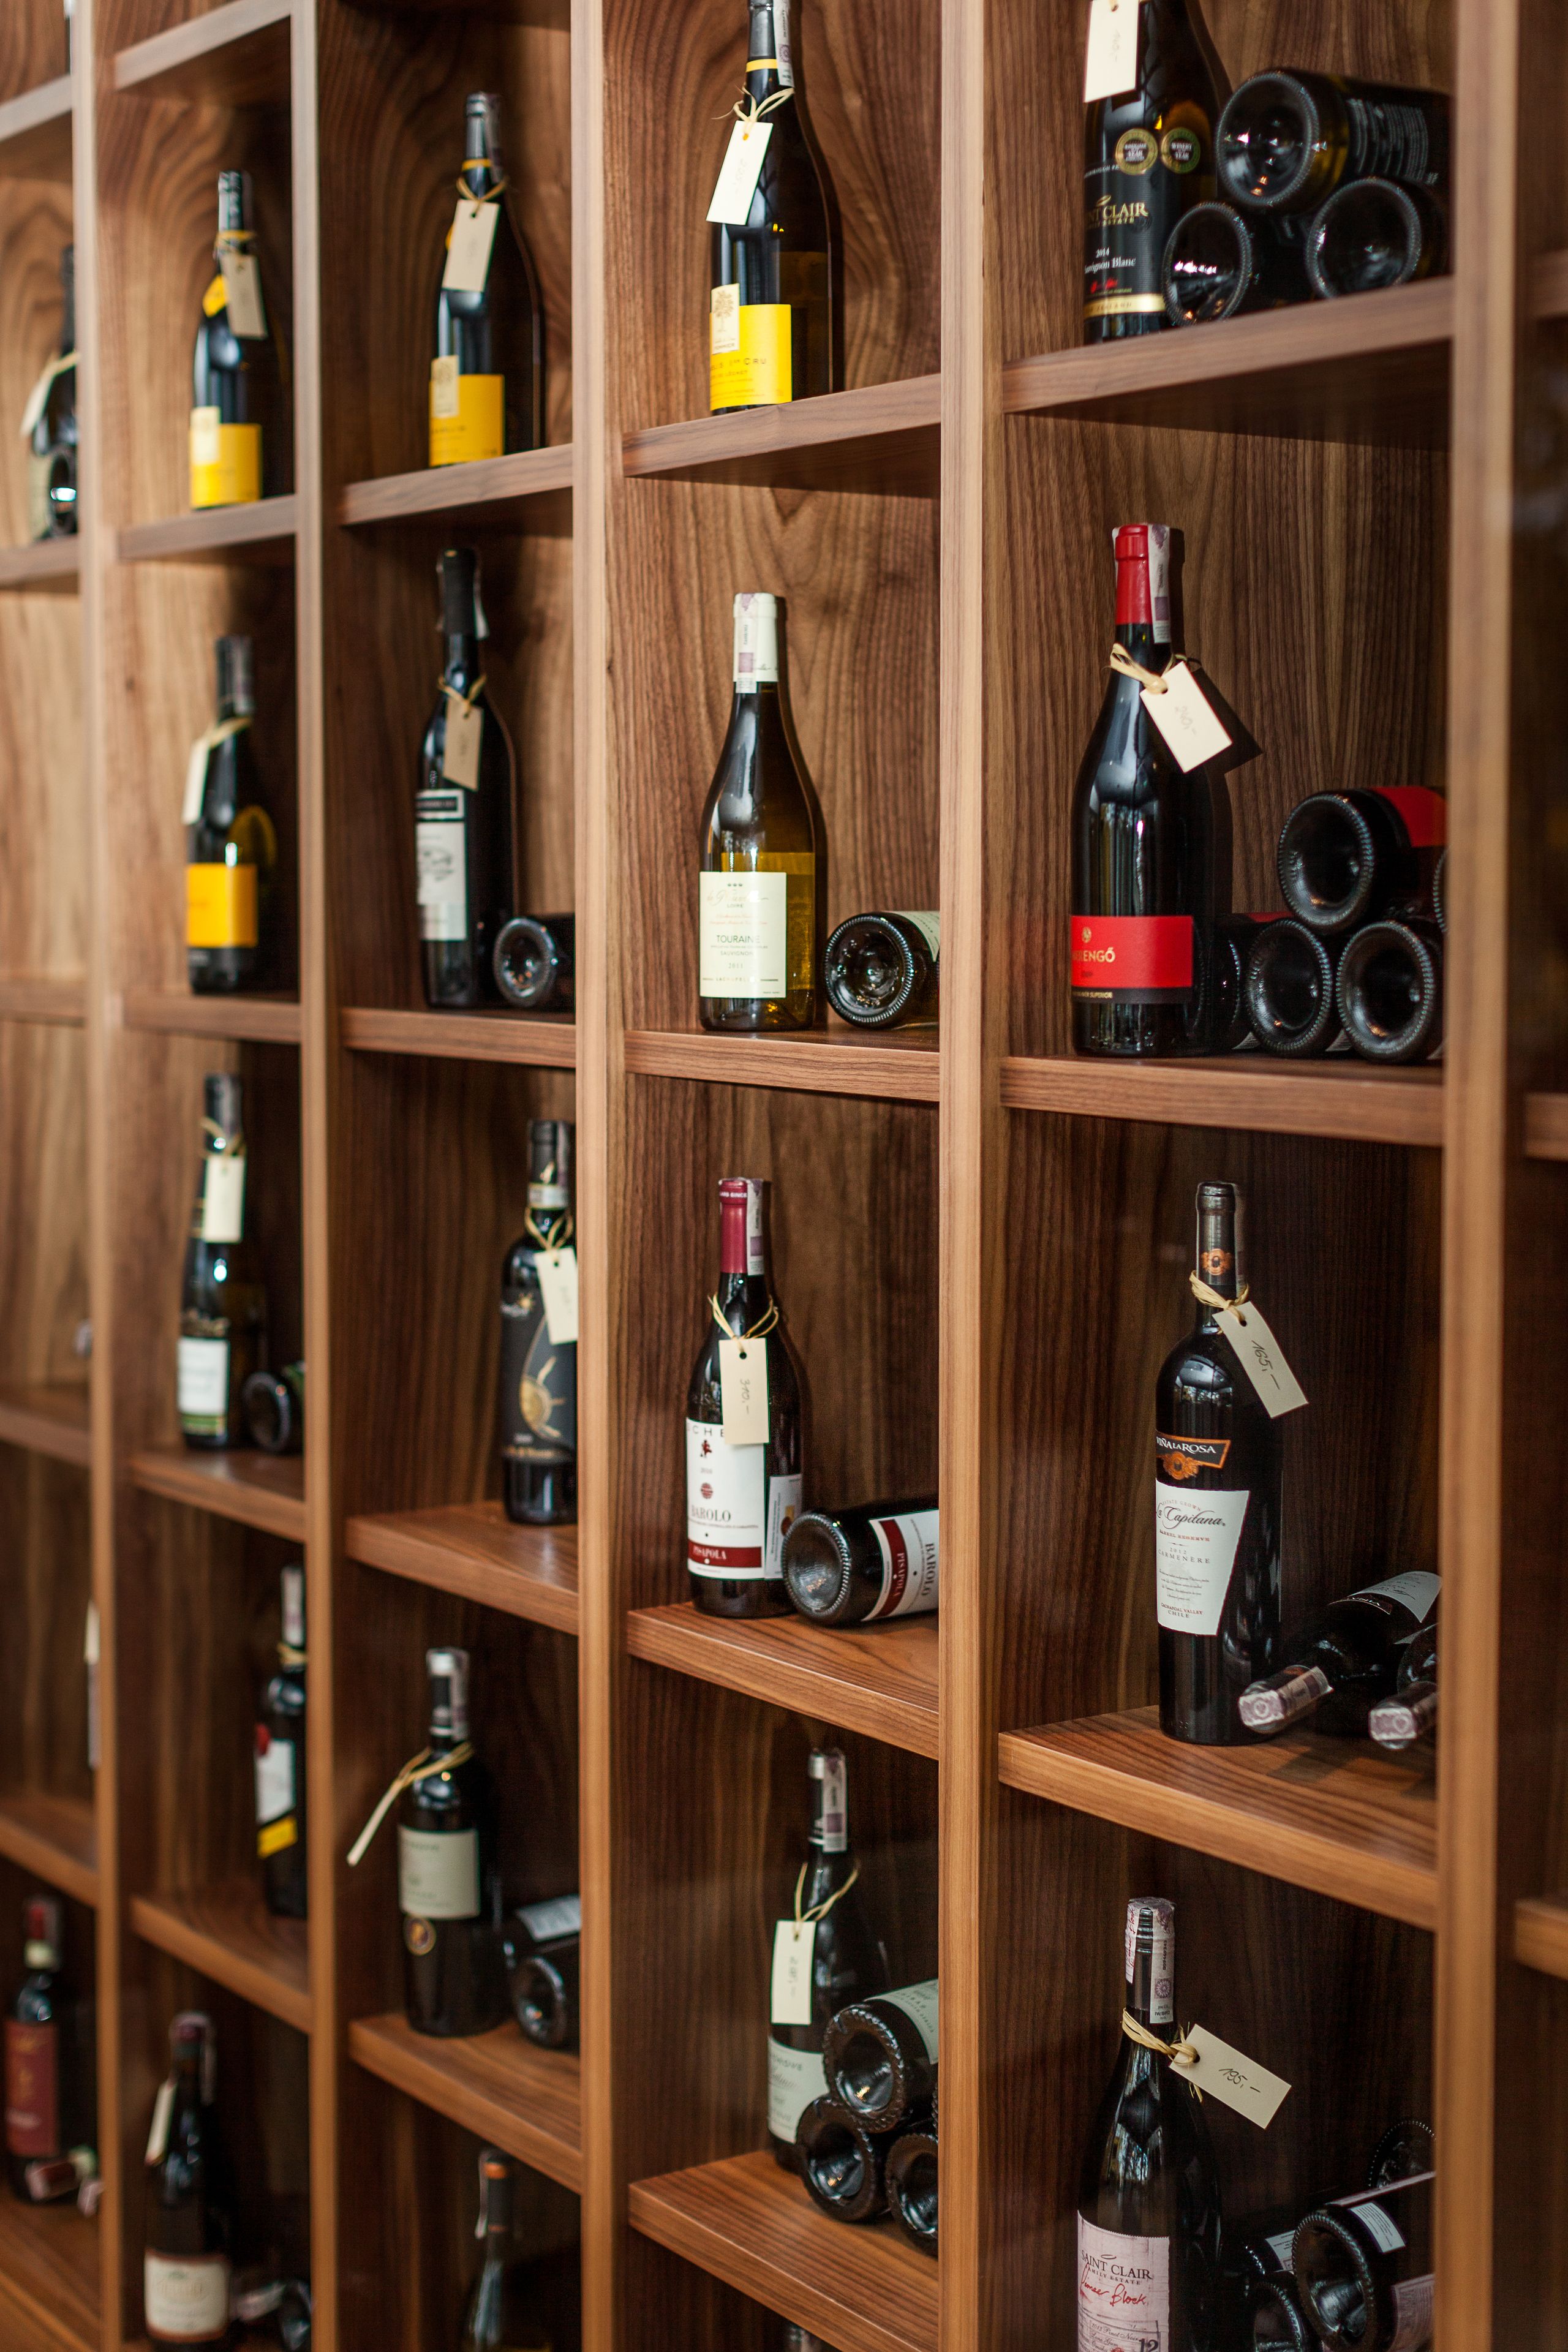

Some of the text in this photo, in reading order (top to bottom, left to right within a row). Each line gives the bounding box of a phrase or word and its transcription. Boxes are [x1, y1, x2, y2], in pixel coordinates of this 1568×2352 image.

[1103, 202, 1149, 219] CLAIR
[1096, 246, 1110, 258] 2014
[1112, 256, 1137, 268] Blanc
[716, 934, 760, 944] TOURAINE
[1182, 1442, 1216, 1455] ROSA
[692, 1504, 731, 1523] BAROLO
[1162, 1506, 1223, 1529] Capitana
[921, 1543, 936, 1596] BAROLO
[1081, 2249, 1153, 2280] SAINT CLAIR
[1088, 2267, 1140, 2285] AMILY ESTATE
[1109, 2283, 1147, 2307] Block
